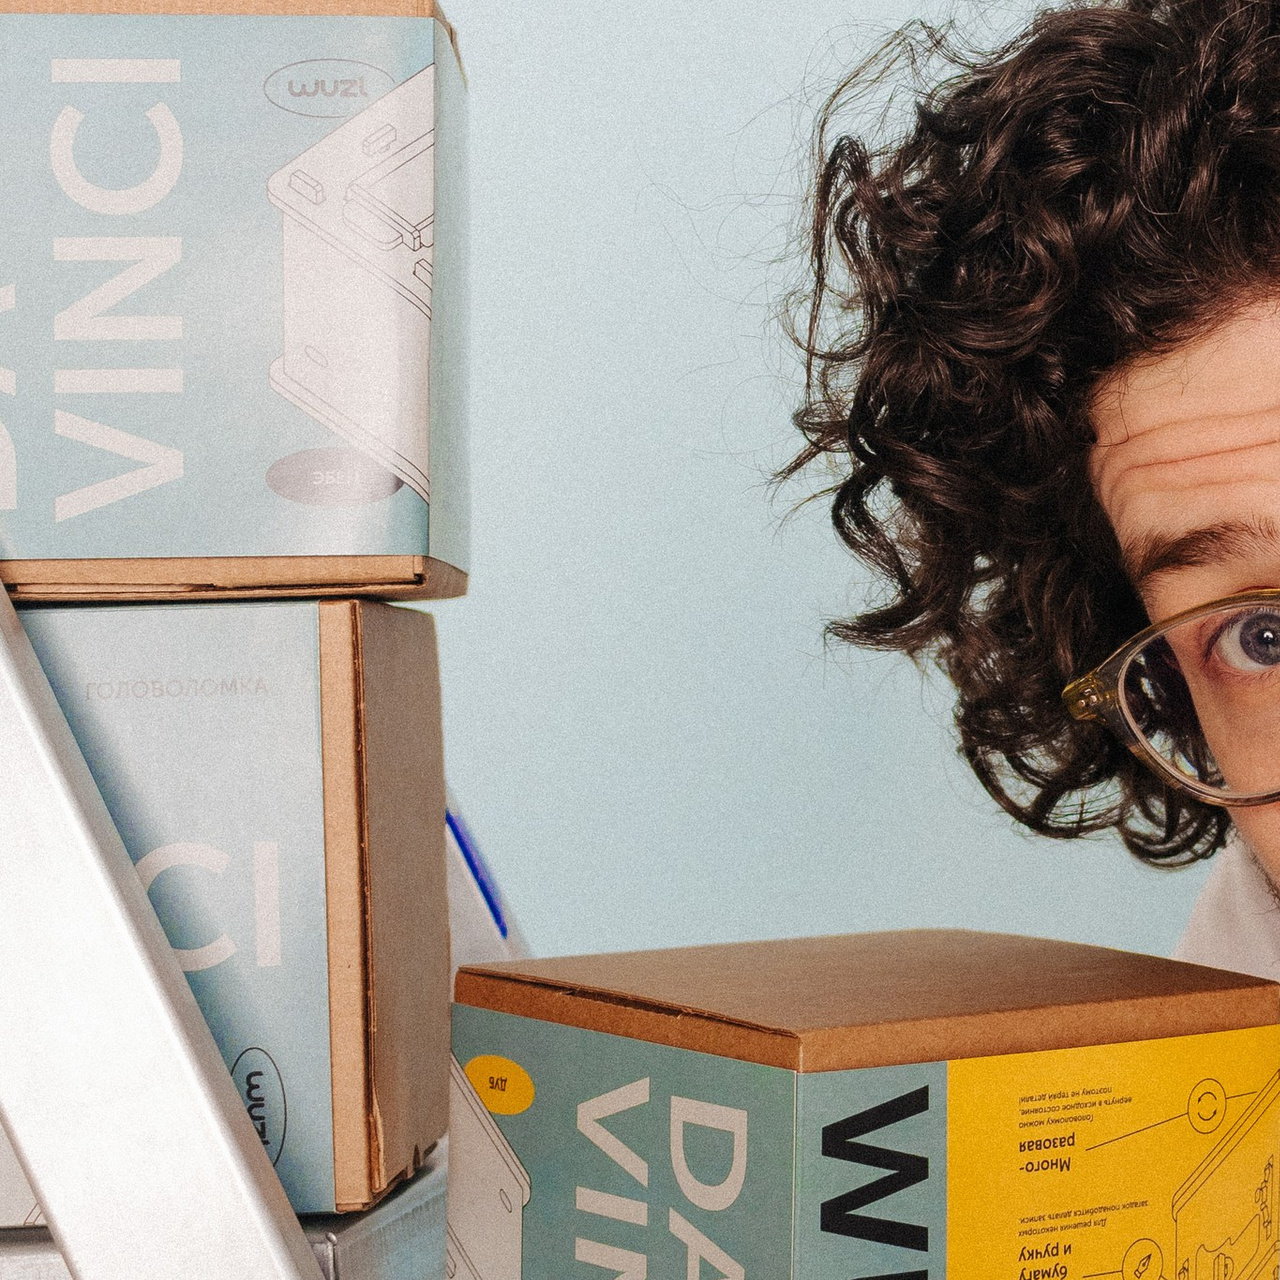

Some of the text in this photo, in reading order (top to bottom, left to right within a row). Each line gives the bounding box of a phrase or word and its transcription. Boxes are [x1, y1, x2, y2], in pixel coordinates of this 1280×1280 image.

[50, 58, 184, 523] VINCI
[85, 676, 270, 701] ГОЛОВОЛОМКА
[489, 1076, 508, 1092] ДУБ
[1049, 1091, 1068, 1101] теряй
[1082, 1086, 1112, 1098] поэтому
[1062, 1099, 1096, 1112] исходное
[1104, 1096, 1132, 1107] вернуть
[1018, 1114, 1093, 1128] Головоломку можно
[1019, 1132, 1075, 1152] разовая
[1019, 1157, 1071, 1173] Много-
[1074, 1204, 1120, 1217] понадобится
[1122, 1200, 1148, 1209] загадок
[1048, 1210, 1072, 1219] делать
[1018, 1218, 1107, 1237] Для решения некоторых
[1018, 1242, 1072, 1262] и ручку
